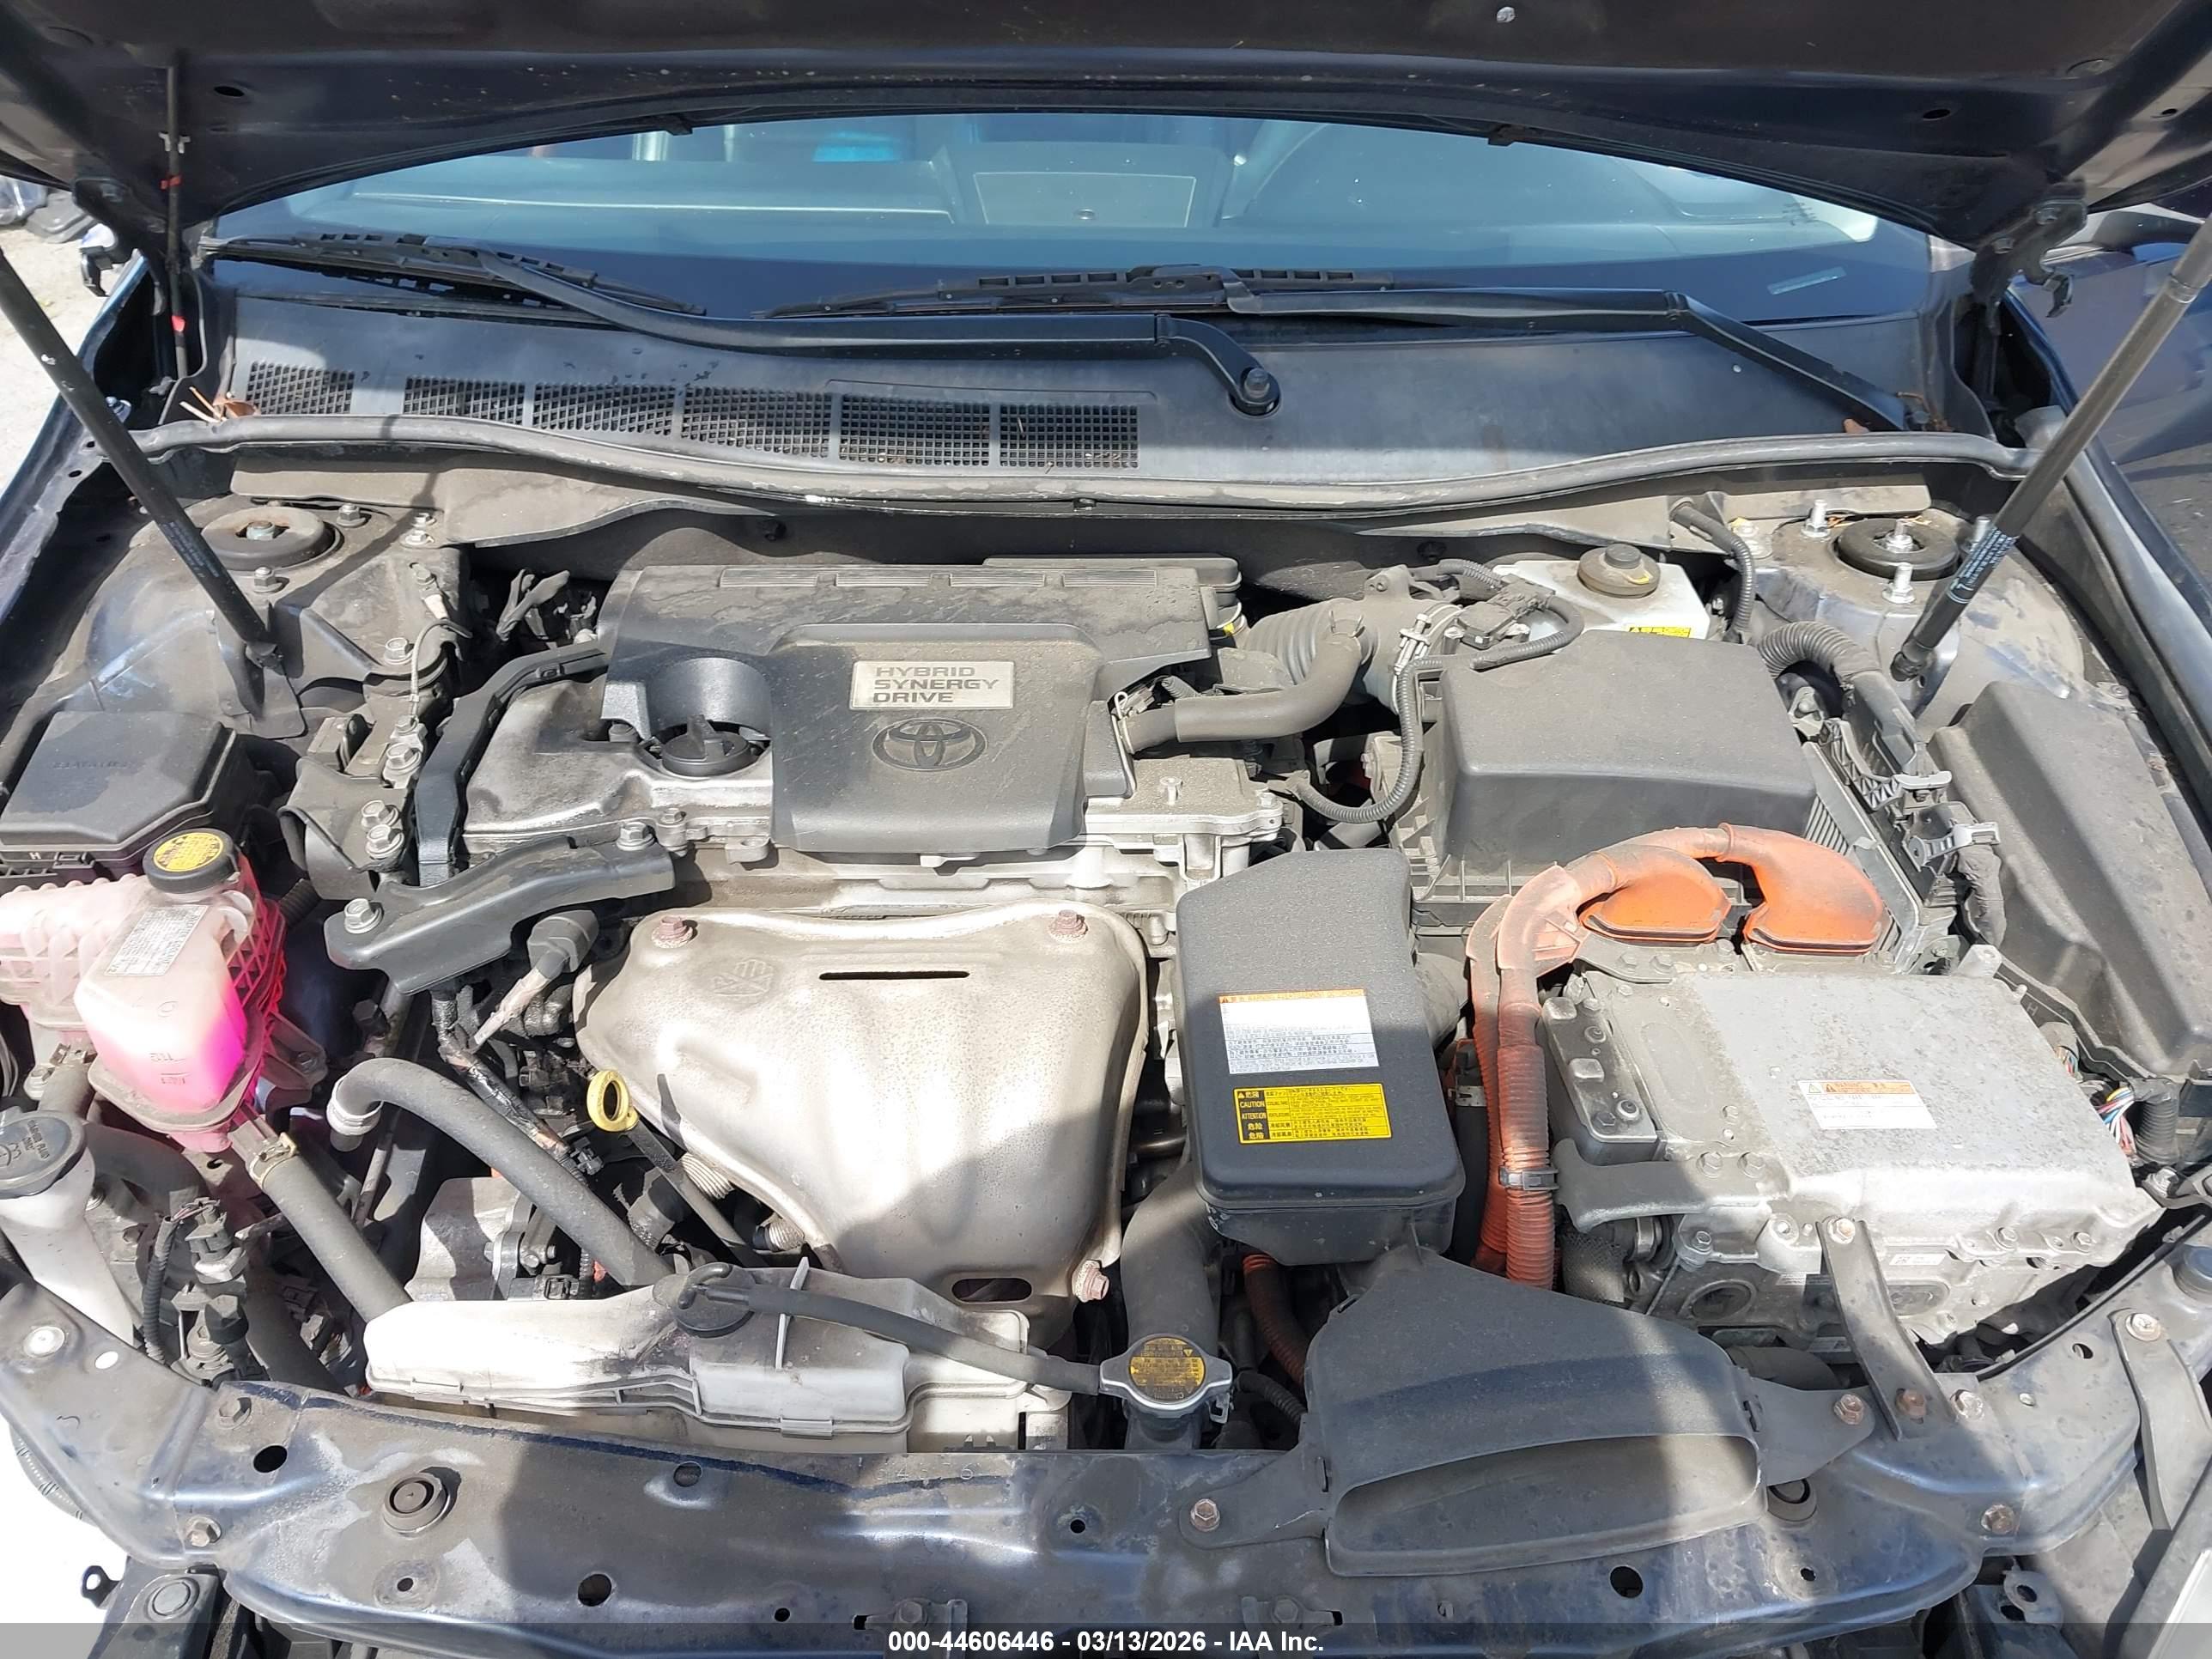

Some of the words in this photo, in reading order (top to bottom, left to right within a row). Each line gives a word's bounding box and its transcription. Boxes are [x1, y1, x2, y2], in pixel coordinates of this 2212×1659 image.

[875, 666, 976, 678] HYBRID
[873, 678, 1000, 690] SYNERGY
[872, 691, 954, 703] DRIVE
